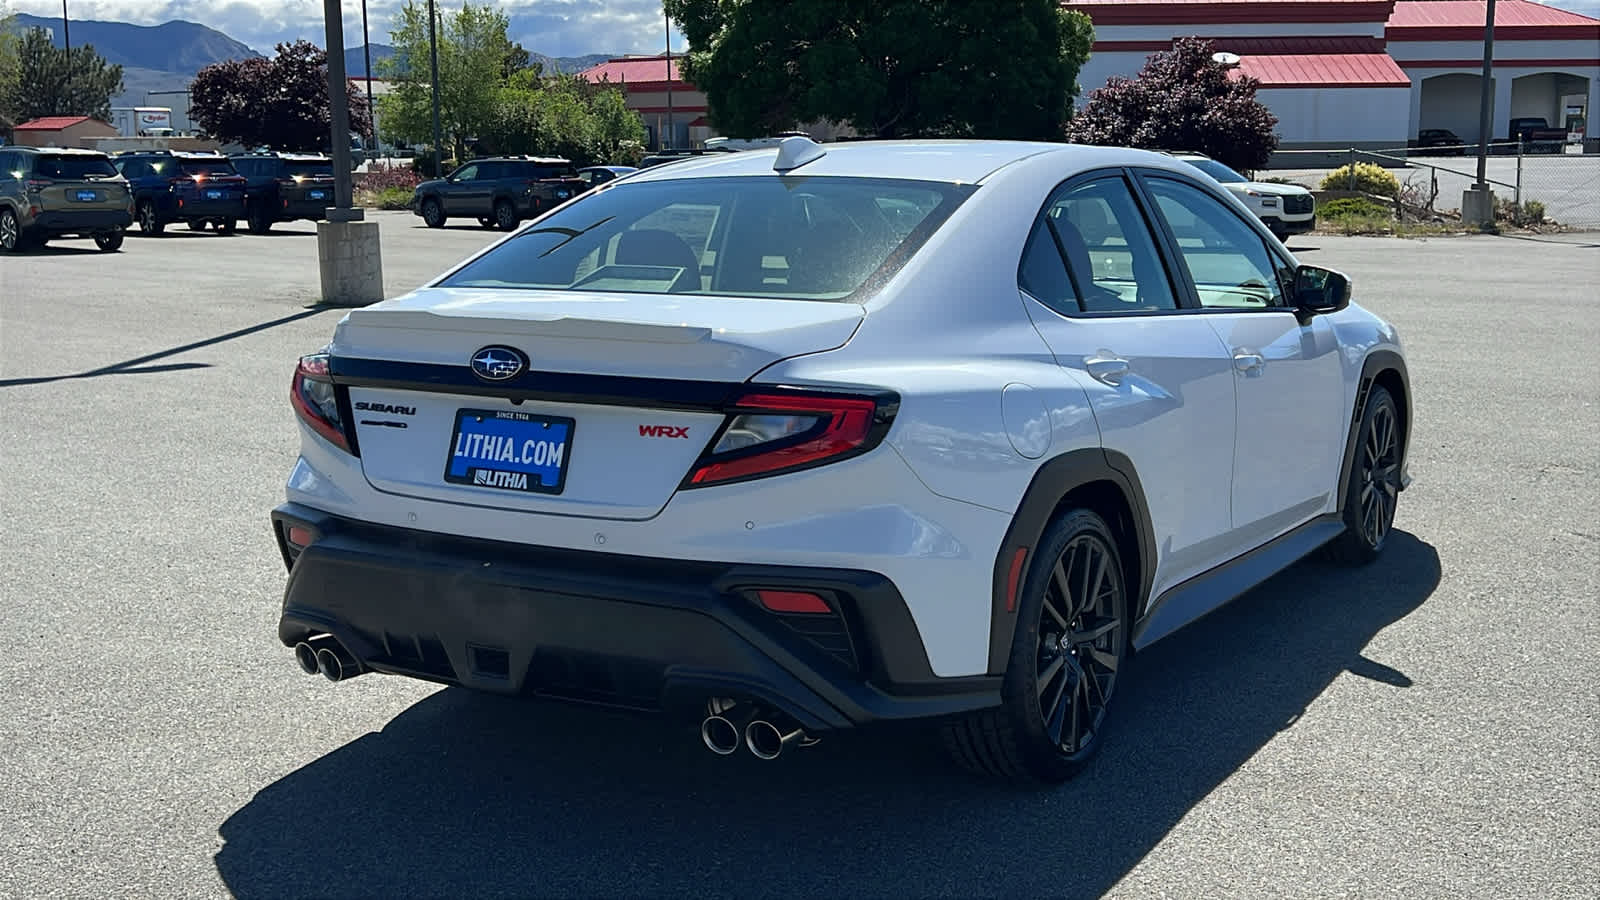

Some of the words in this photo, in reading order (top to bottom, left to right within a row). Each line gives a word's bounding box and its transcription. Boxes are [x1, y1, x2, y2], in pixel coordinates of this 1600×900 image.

[354, 401, 417, 416] SUBARU
[496, 411, 513, 420] SINCE
[639, 424, 690, 439] WRX
[454, 432, 565, 468] LITHIA.COM
[486, 470, 528, 490] LITHIA
